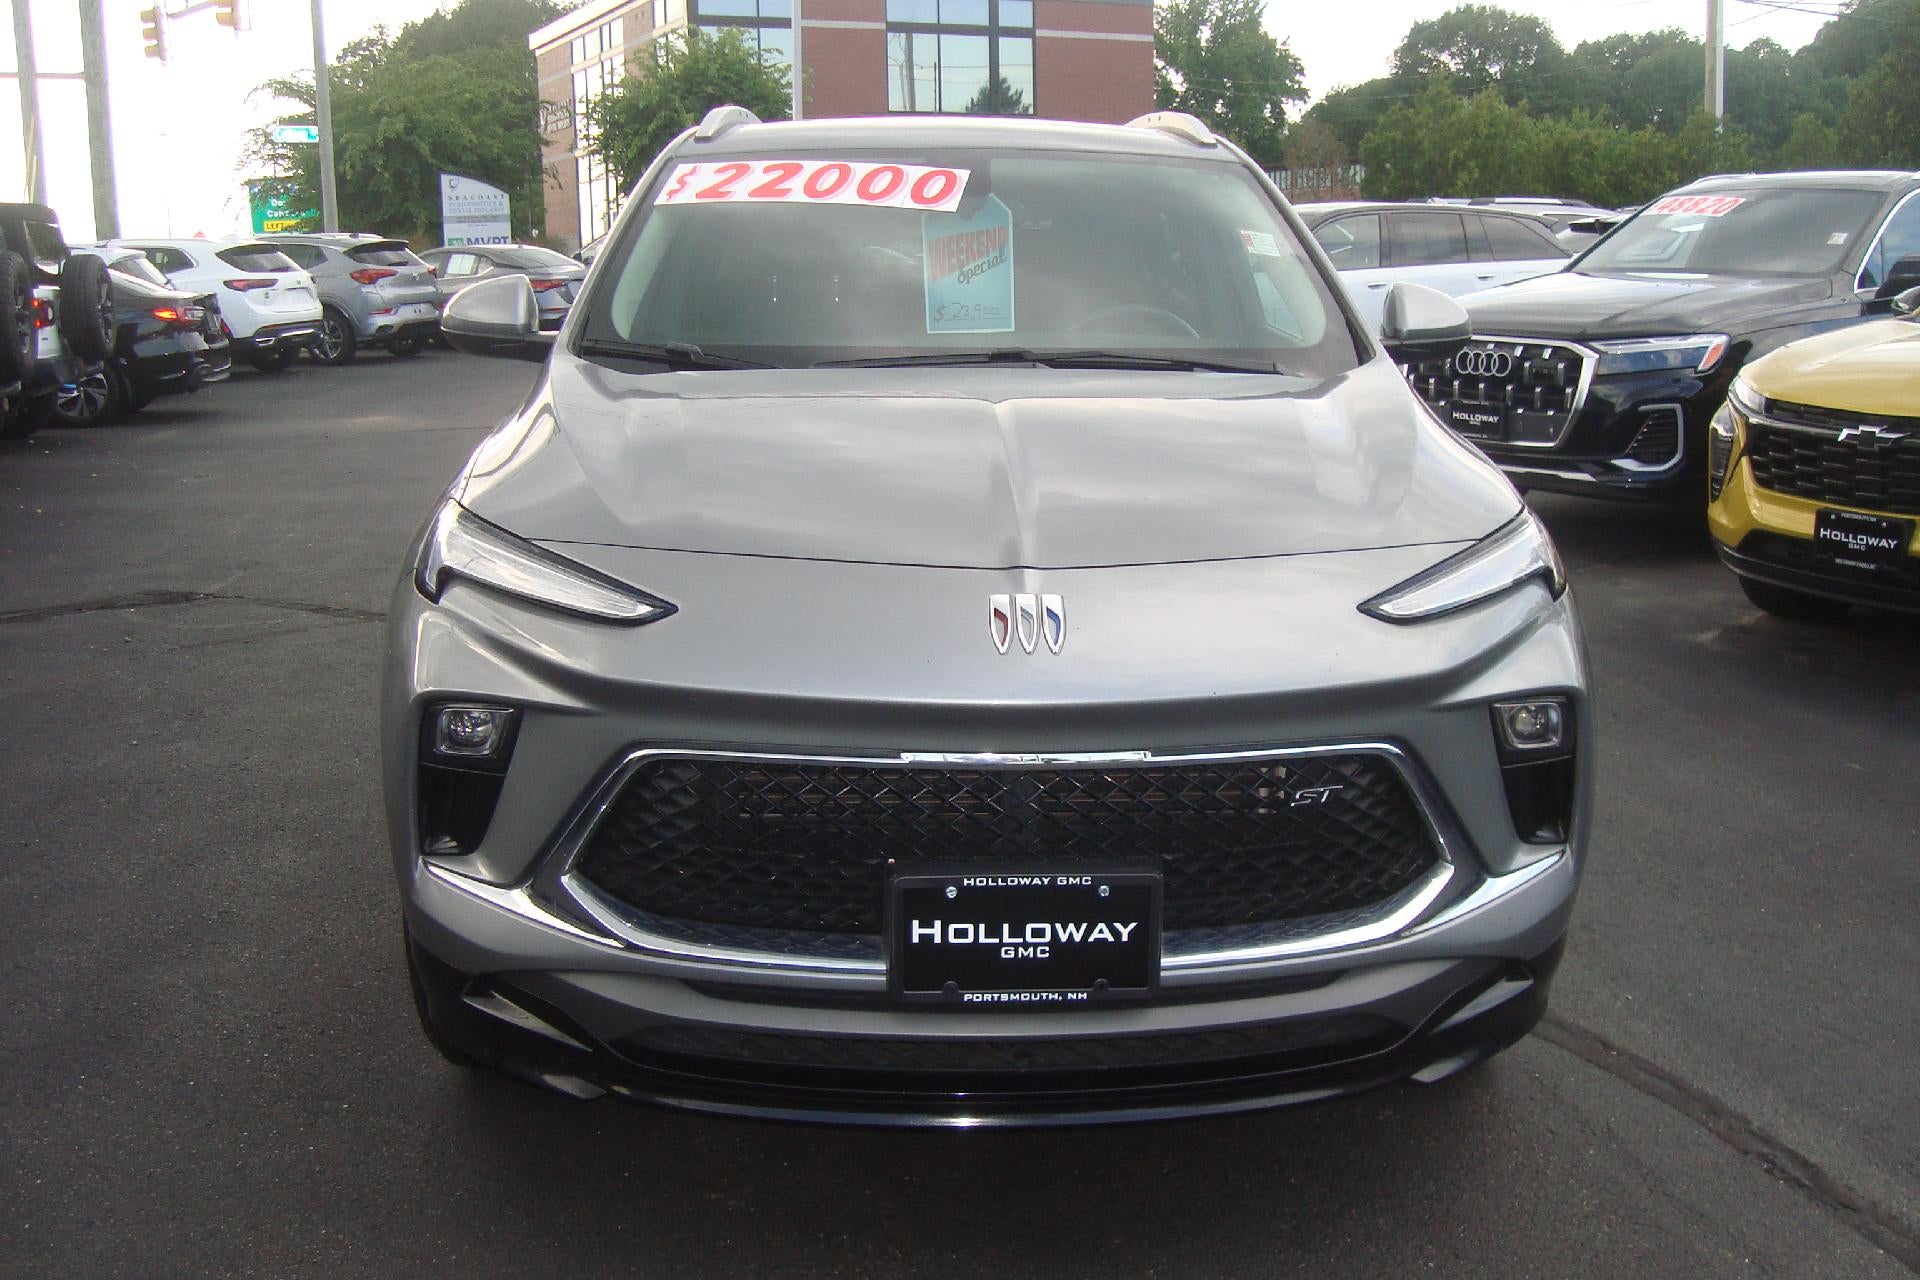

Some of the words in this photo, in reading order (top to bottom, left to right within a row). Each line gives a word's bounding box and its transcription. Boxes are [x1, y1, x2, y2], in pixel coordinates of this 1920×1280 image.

[929, 226, 1009, 284] WEEKEND
[957, 248, 1008, 285] Special
[1452, 411, 1500, 423] HOLLOWAY
[1819, 527, 1898, 549] HOLLOWAY
[1290, 785, 1343, 807] ST
[963, 876, 1052, 887] HOLLOWAY
[1056, 876, 1092, 886] GMC
[911, 919, 1138, 944] HOLLOWAY
[1000, 946, 1050, 959] GMC
[963, 992, 1063, 1002] PORTSMOUTH,
[1067, 991, 1088, 1000] NH
